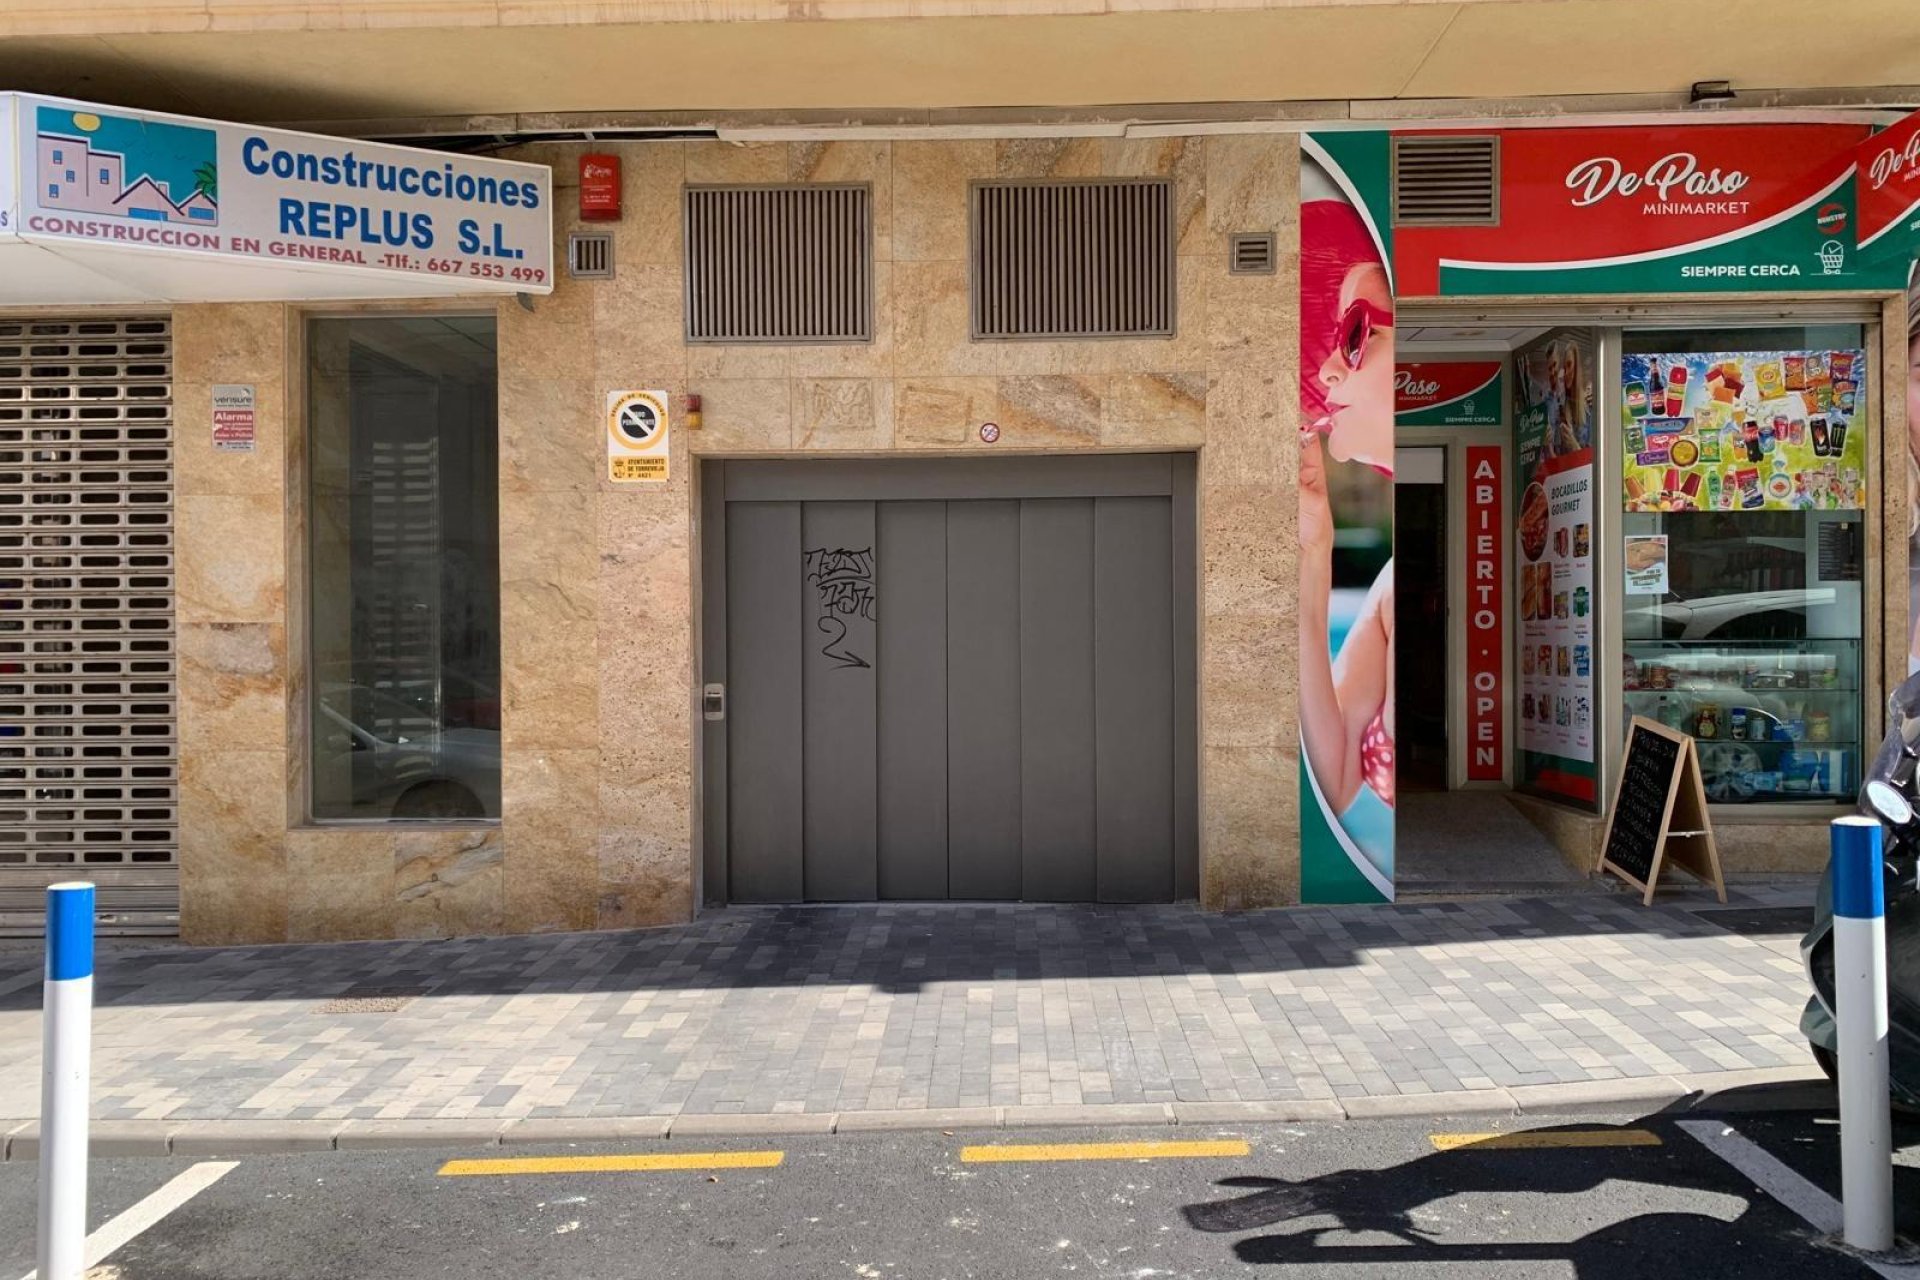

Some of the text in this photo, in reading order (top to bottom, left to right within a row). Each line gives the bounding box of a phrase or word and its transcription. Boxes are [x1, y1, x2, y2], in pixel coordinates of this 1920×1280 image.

[243, 137, 539, 208] Construcciones
[1565, 152, 1749, 206] De Paso
[279, 198, 523, 259] REPLUS S.L.
[1643, 202, 1750, 215] MINIMARKET
[29, 215, 220, 250] CONSTRUCCION
[231, 238, 260, 254] EN
[269, 241, 367, 265] GENERAL
[427, 258, 463, 274] 667
[470, 264, 504, 278] 553
[511, 268, 545, 283] 499
[1681, 265, 1801, 278] SIEMPRE CERCA
[215, 411, 253, 421] Alarma
[1551, 480, 1588, 500] BOCADILLOS
[1551, 499, 1580, 516] GOURMET
[1473, 459, 1496, 630] ABIERTO
[1474, 671, 1496, 766] OPEN
